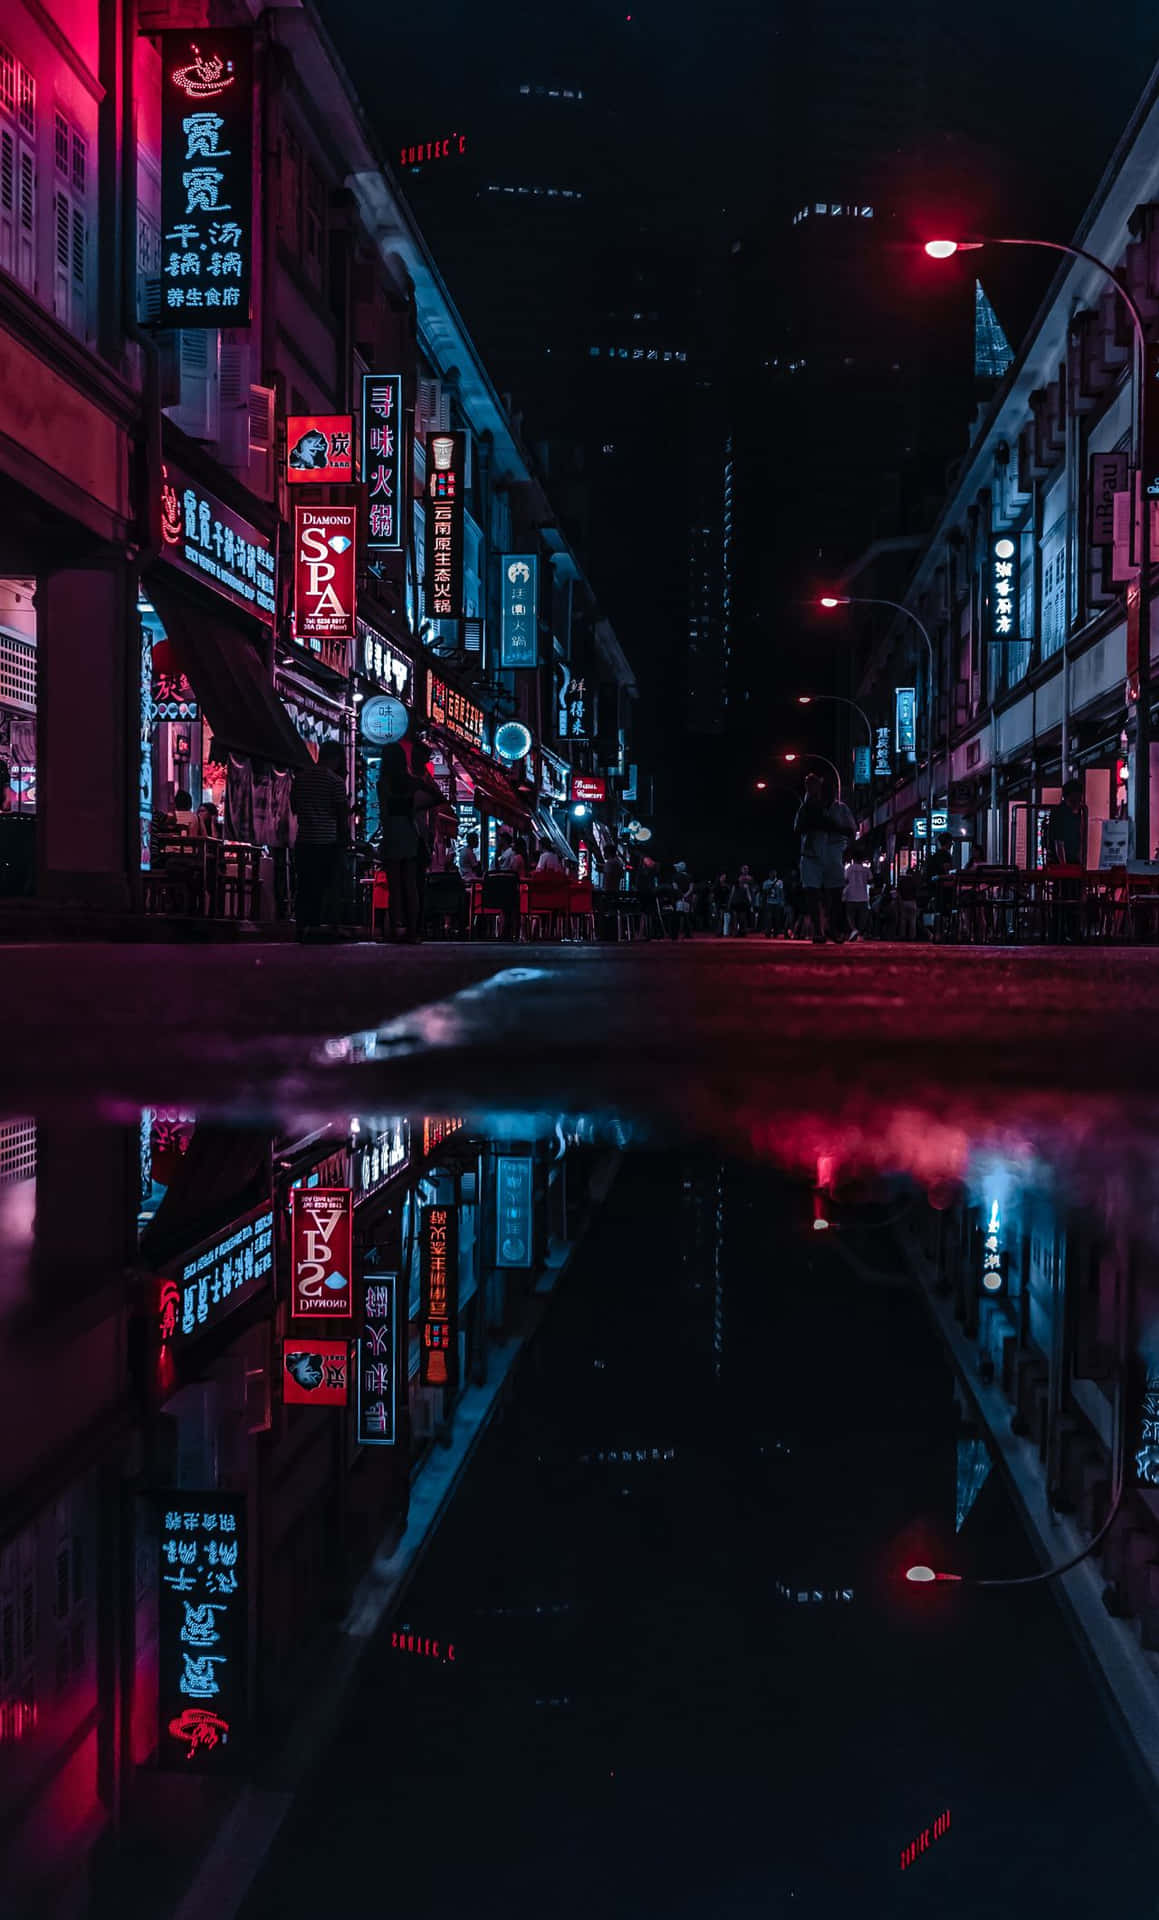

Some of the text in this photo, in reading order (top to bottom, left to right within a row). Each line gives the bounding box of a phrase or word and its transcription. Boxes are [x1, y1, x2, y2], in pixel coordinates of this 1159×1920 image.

[369, 384, 394, 538] 寻味火锅
[300, 527, 351, 617] SPA
[433, 501, 454, 613] 云南原生态火锅
